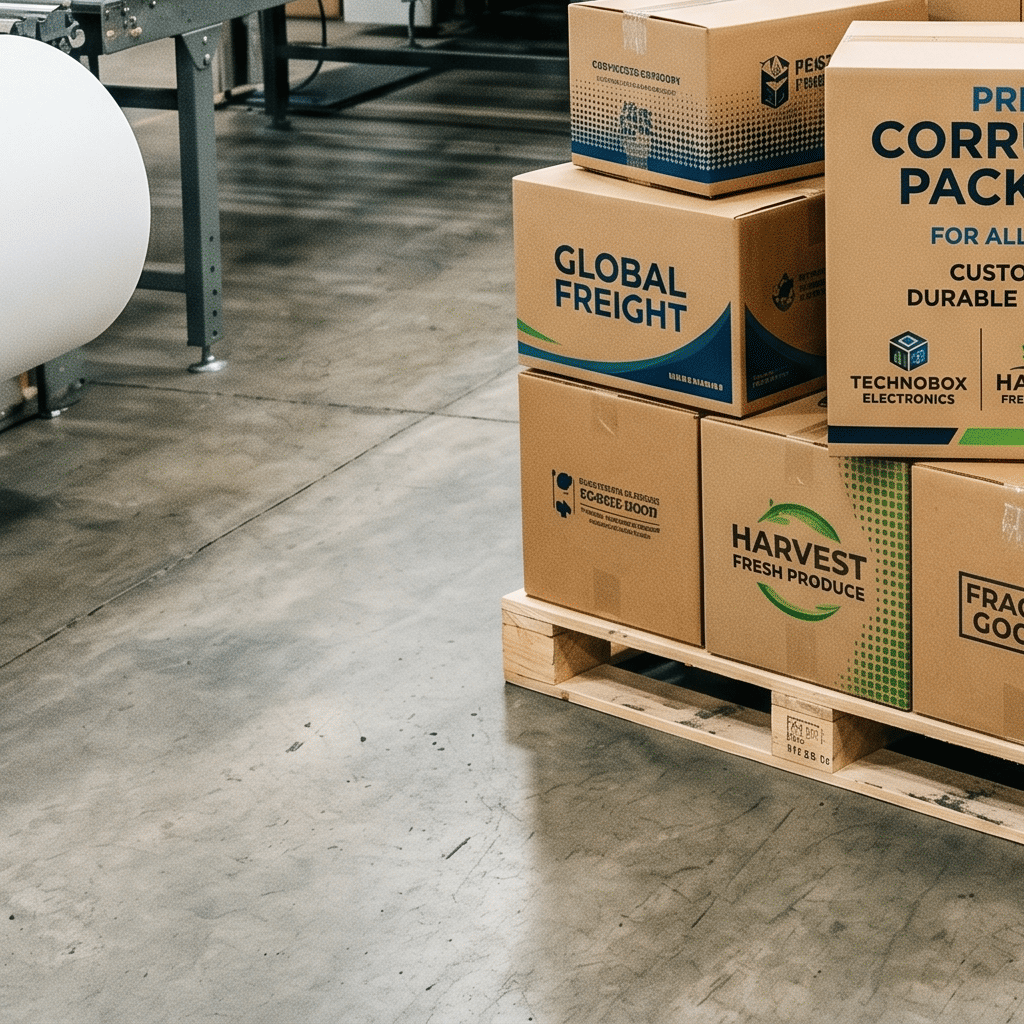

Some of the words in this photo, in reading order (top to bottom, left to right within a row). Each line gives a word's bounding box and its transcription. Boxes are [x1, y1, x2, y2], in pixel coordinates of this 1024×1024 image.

[931, 226, 979, 246] FOR
[554, 244, 687, 299] GLOBAL
[555, 278, 688, 333] FREIGHT
[907, 288, 1018, 308] DURABLE
[849, 375, 968, 391] TECHNOBOX
[862, 392, 956, 405] ELECTRONICS
[731, 523, 868, 581] HARVEST
[732, 553, 784, 581] FRESH
[787, 567, 866, 602] PRODUCE
